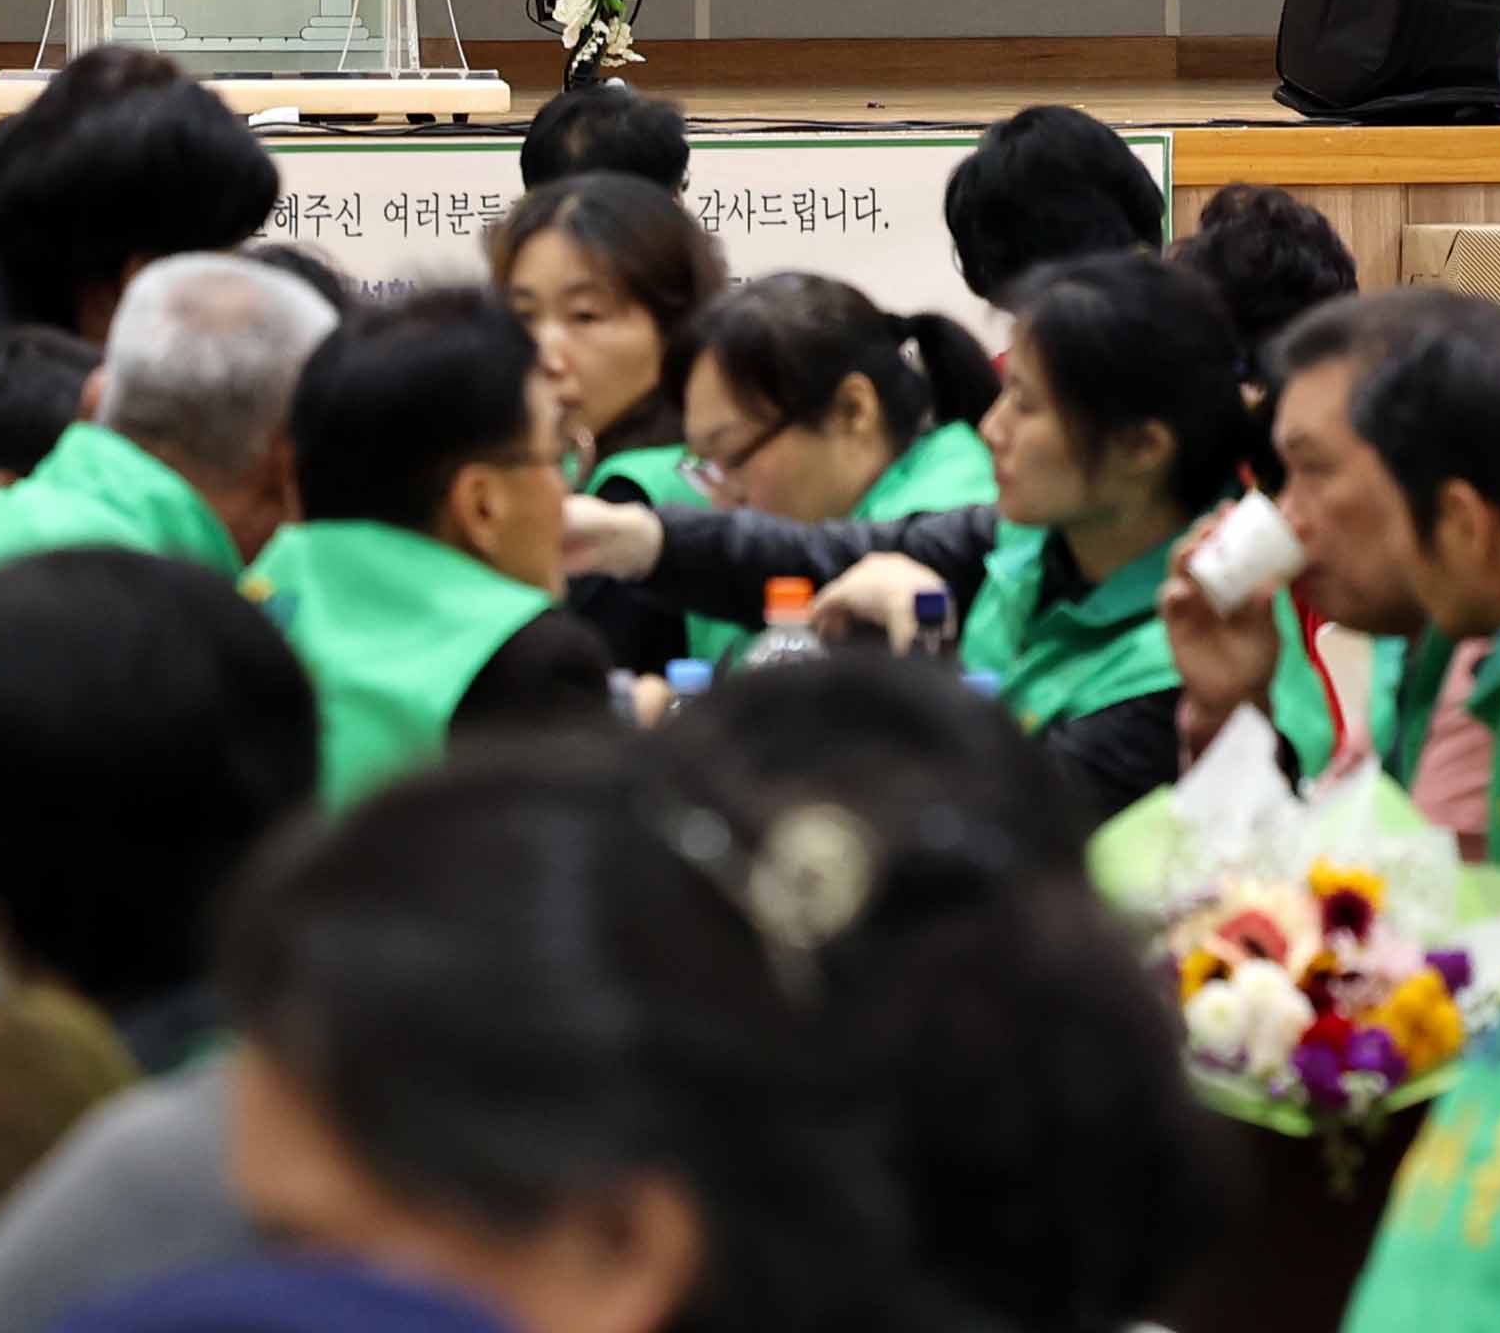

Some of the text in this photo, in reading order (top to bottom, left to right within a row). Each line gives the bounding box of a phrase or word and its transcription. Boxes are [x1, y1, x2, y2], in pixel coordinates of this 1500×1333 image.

[252, 186, 890, 239] 해주신 여러분들 감사드립니다.
